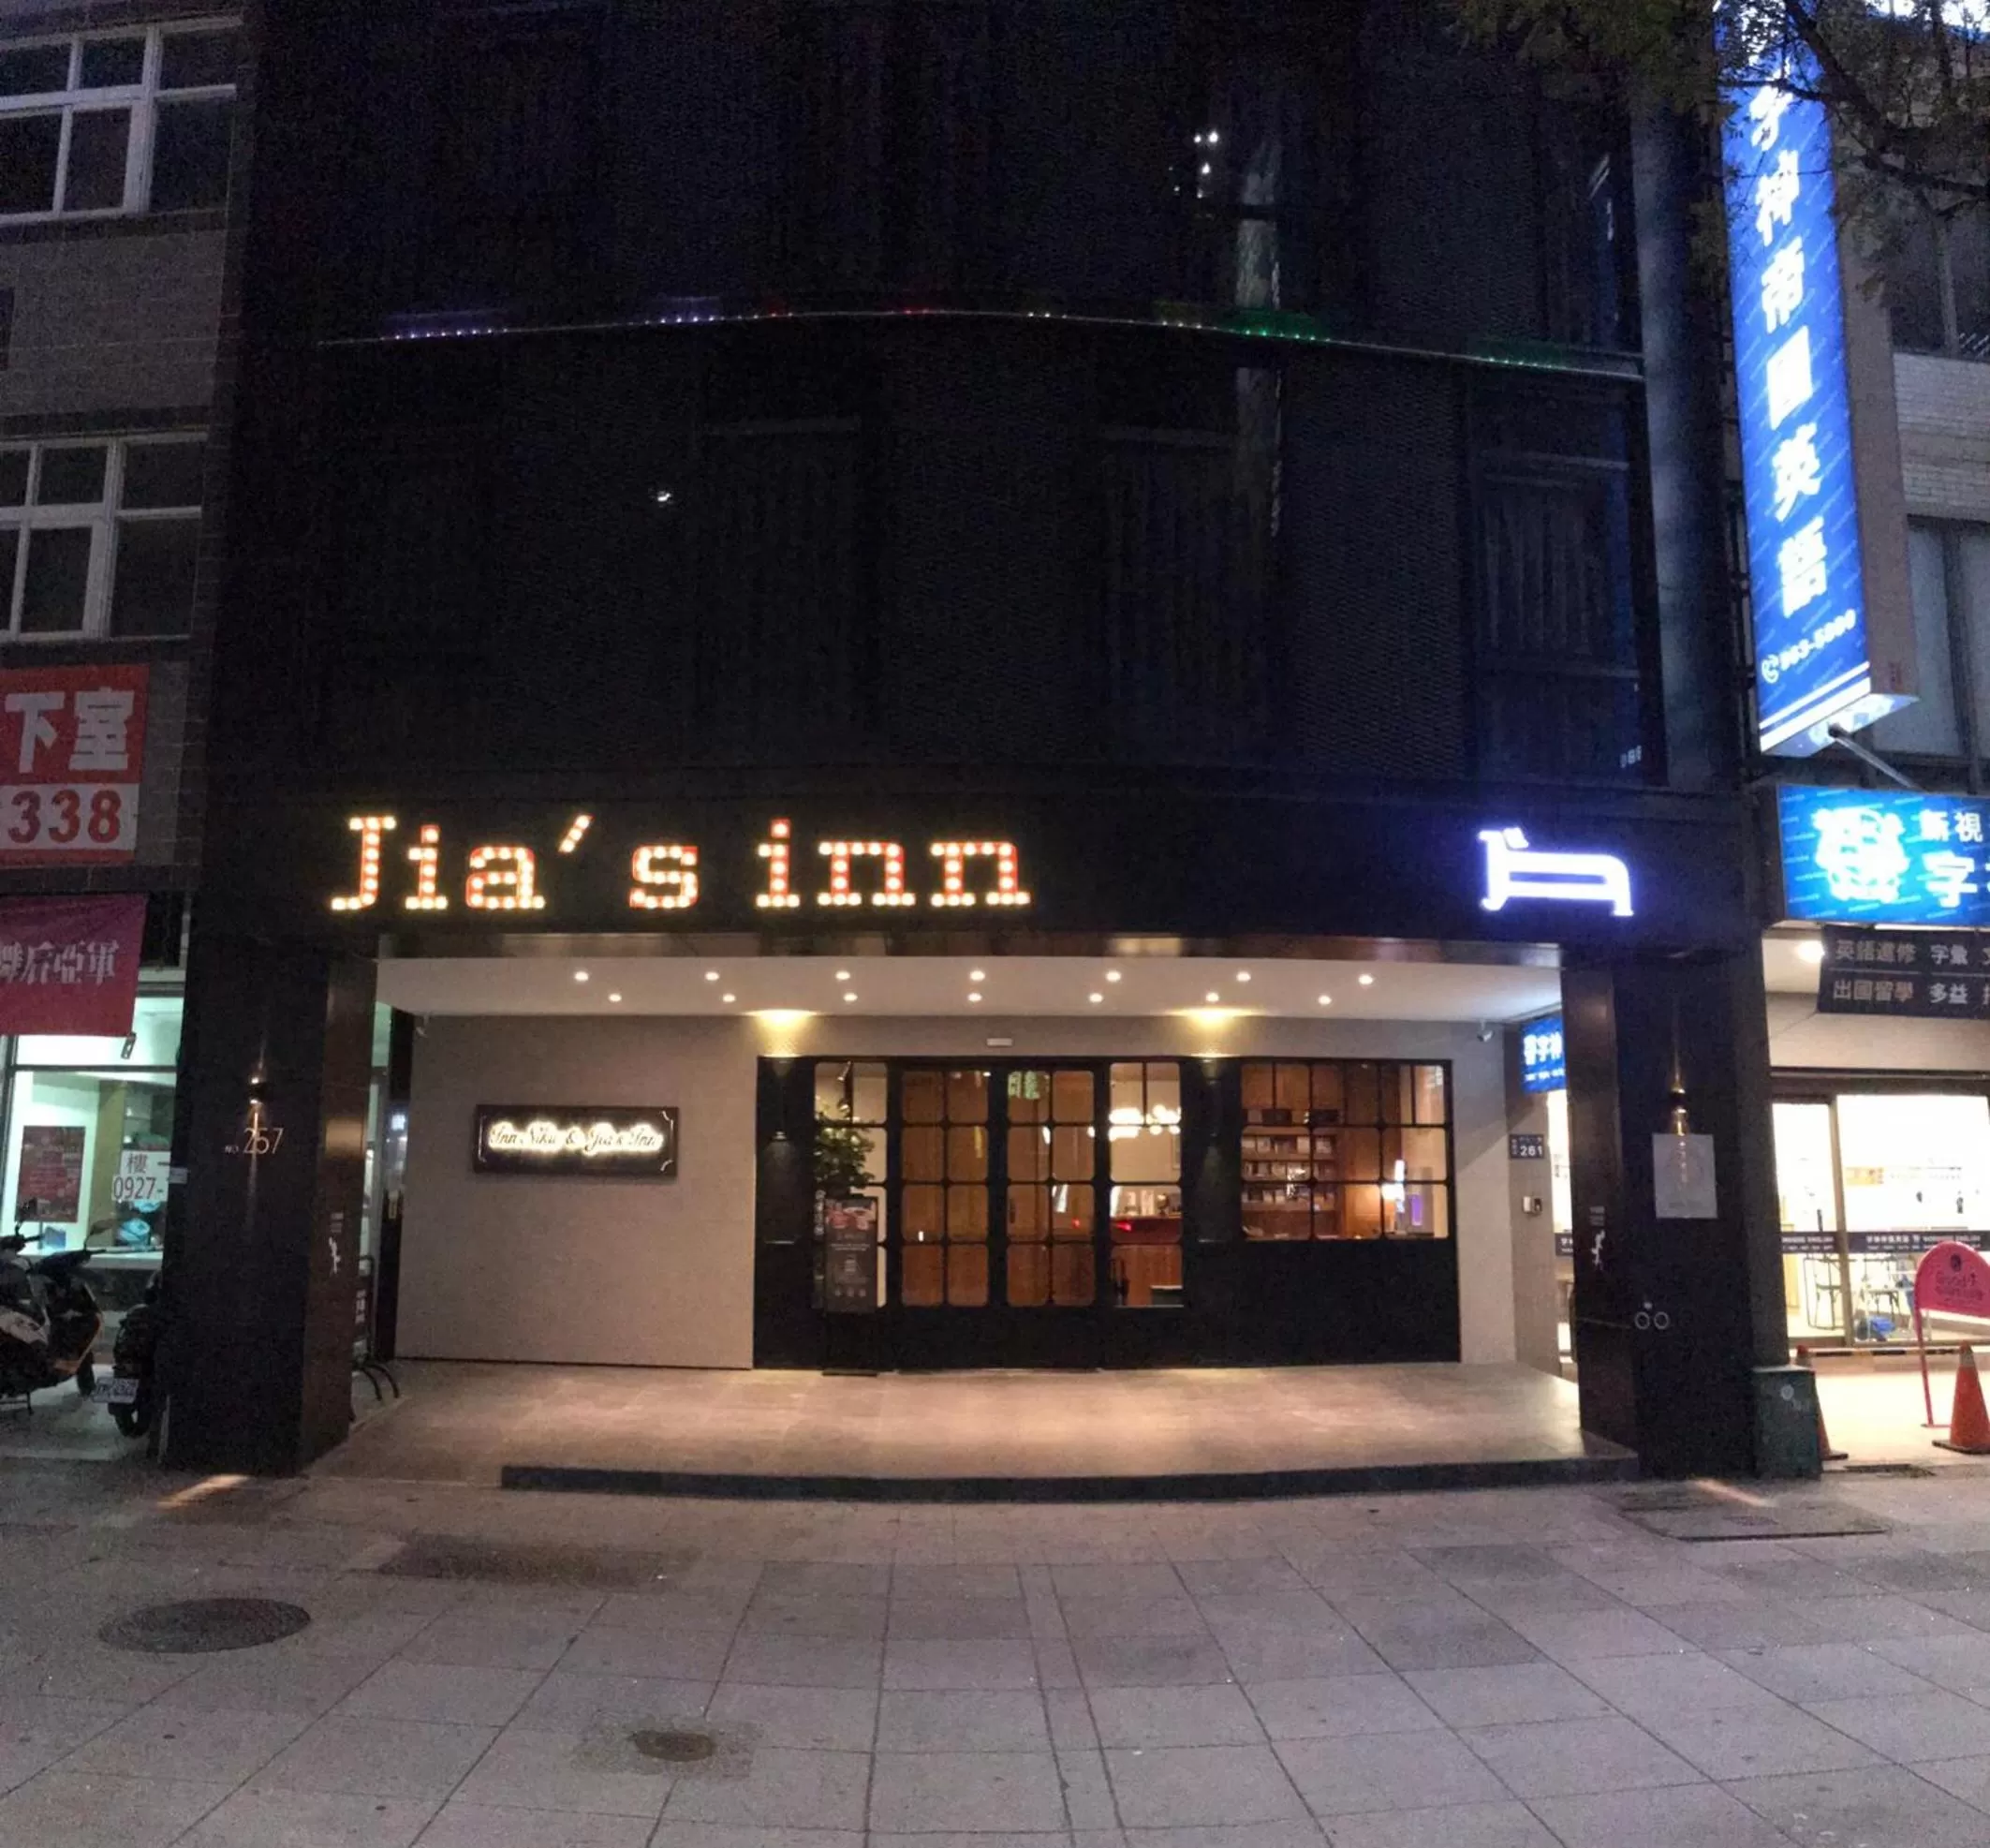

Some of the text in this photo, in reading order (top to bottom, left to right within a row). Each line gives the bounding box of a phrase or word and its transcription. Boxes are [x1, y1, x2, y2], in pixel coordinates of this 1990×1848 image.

[5, 687, 134, 774] 下室
[7, 790, 121, 843] 338
[331, 815, 1030, 909] Jia's inn
[1922, 850, 1990, 909] 字
[1833, 979, 1914, 1003] 出國留學
[1929, 983, 1968, 1004] 多益
